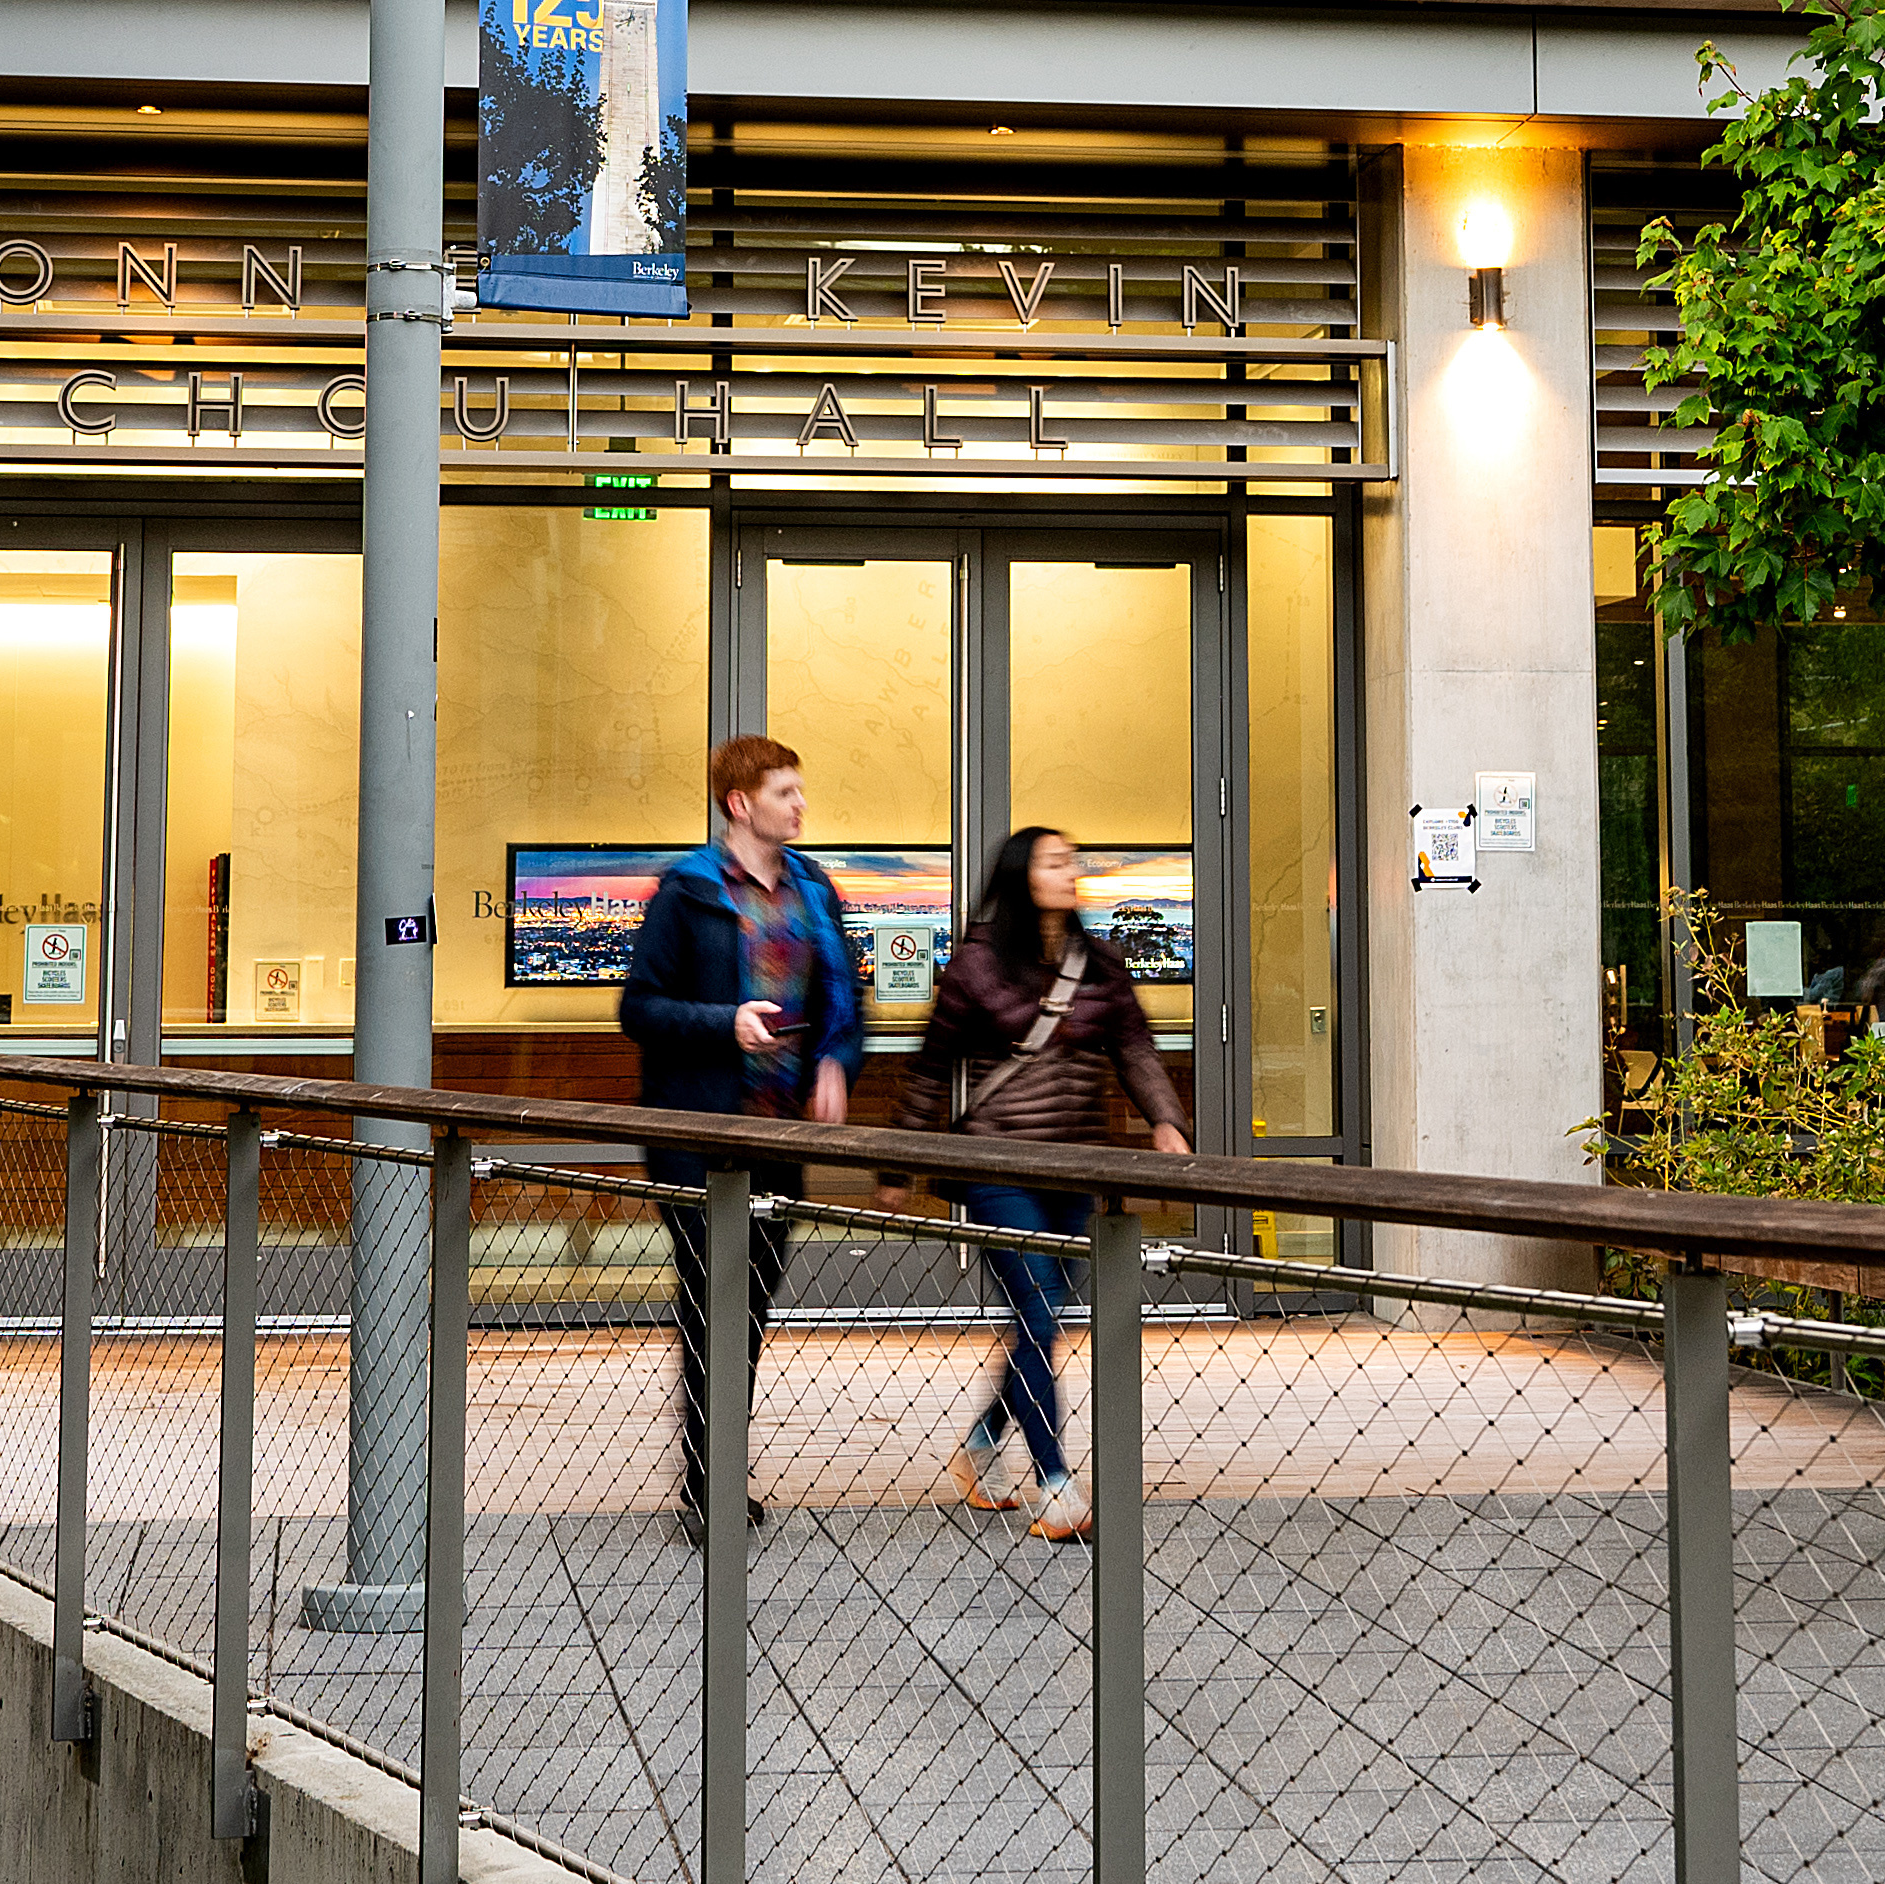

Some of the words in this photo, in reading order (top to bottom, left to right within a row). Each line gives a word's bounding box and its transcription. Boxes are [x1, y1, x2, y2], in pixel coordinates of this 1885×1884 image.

[513, 24, 604, 52] YEARS
[632, 261, 680, 280] Berkeley
[805, 257, 1239, 329] KEVIN
[58, 370, 509, 442] CHOU
[675, 380, 1069, 450] HALL
[1086, 858, 1122, 869] Economy
[1125, 957, 1185, 972] BerkeleyHaas
